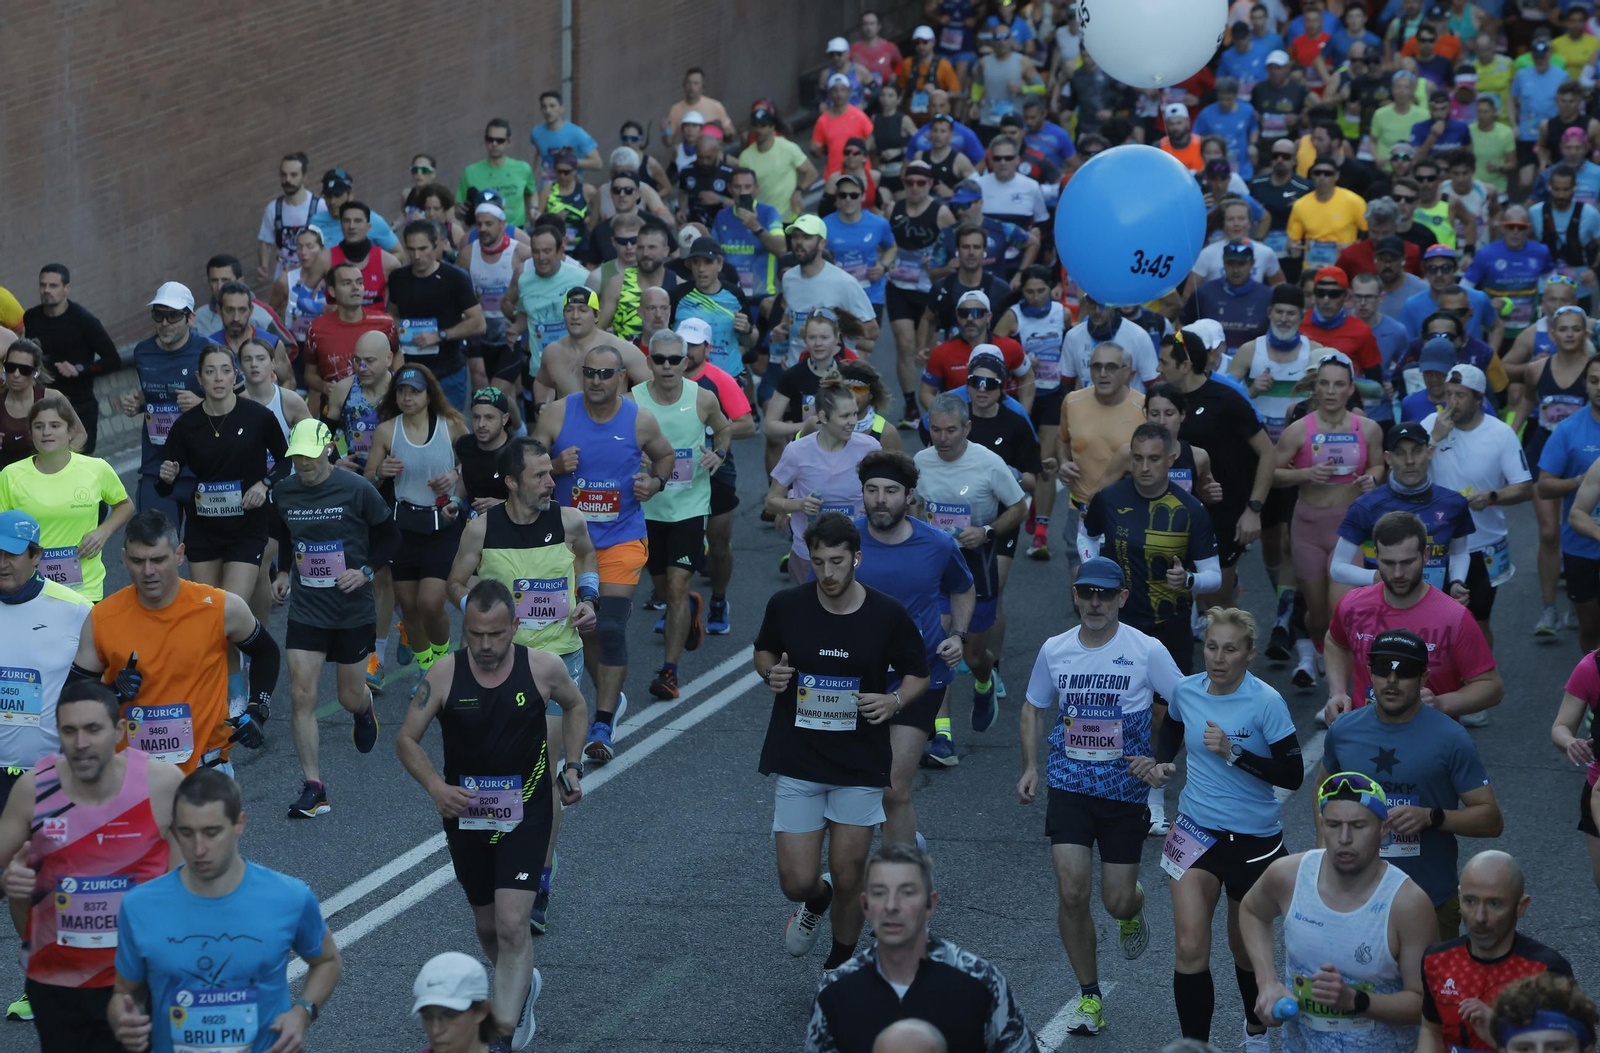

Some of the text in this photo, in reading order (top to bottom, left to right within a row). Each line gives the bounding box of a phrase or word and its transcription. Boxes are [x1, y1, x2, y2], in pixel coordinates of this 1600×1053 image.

[1130, 250, 1174, 279] 3:45
[220, 506, 242, 514] BRAID
[576, 501, 613, 512] ASHRAF
[44, 550, 74, 558] ZURICH
[308, 566, 332, 576] JOSE
[534, 582, 563, 590] ZURICH
[528, 606, 556, 618] JUAN
[819, 648, 850, 658] ambie
[1, 670, 36, 680] ZURICH
[820, 679, 852, 688] ZURICH
[1058, 674, 1130, 691] ES MONTGERON
[817, 695, 840, 704] 11847
[1066, 690, 1120, 705] ATHLÉTISME
[0, 699, 24, 711] UAN
[147, 708, 183, 718] ZURICH
[823, 710, 857, 719] MARTÍNEZ
[148, 727, 168, 735] 9460
[1082, 724, 1100, 732] 8988
[140, 738, 180, 750] MARIO
[1070, 735, 1115, 748] PATRICK
[479, 778, 514, 788] ZURICH
[1381, 782, 1418, 794] SKY
[468, 807, 512, 818] MARCO
[1180, 818, 1208, 842] ZURICH
[1392, 834, 1420, 843] PAULA
[82, 880, 128, 892] ZURICH
[84, 902, 108, 912] 8372
[198, 990, 246, 1004] ZURICH
[202, 1015, 226, 1025] 4928
[184, 1028, 246, 1044] BRU PM
